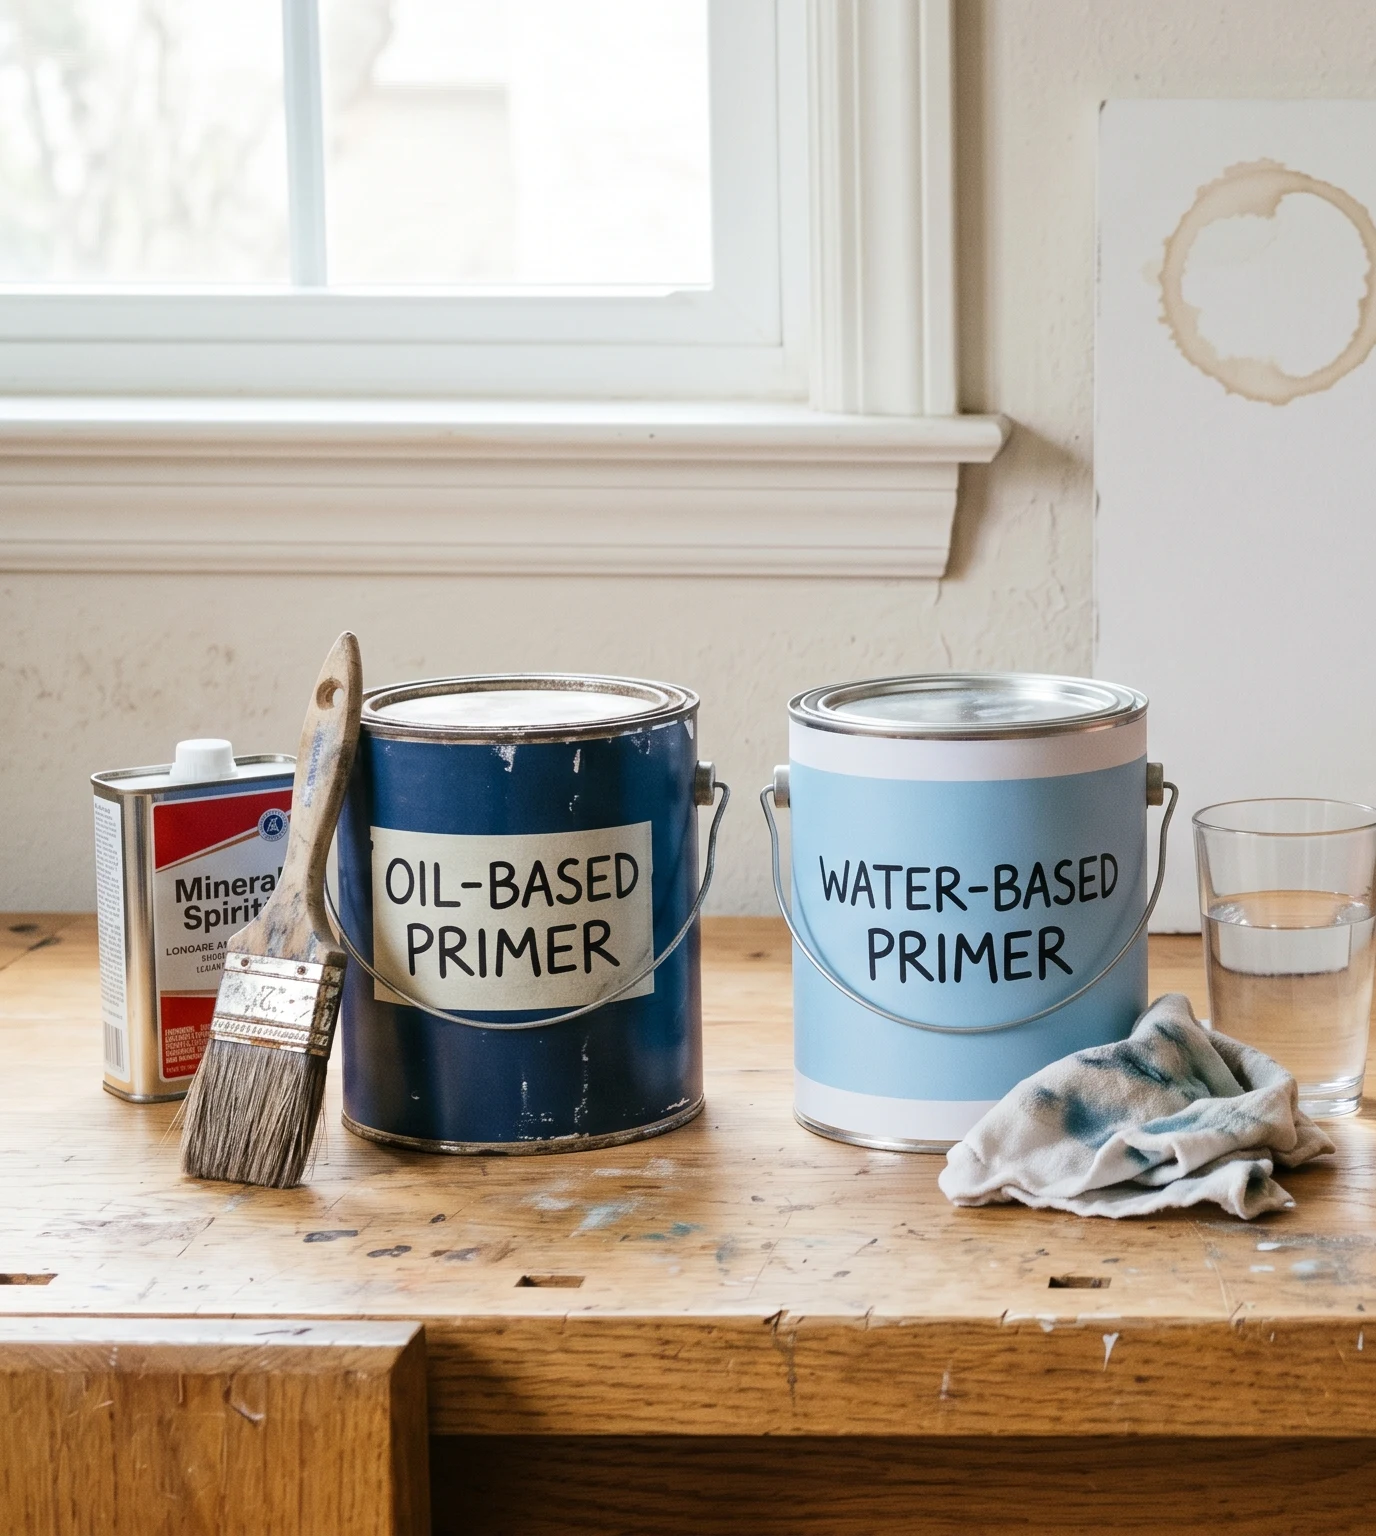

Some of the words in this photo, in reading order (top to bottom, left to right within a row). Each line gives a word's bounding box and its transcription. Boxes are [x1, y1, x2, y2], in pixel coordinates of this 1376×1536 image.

[386, 852, 639, 910] OIL-BASED
[819, 853, 1119, 913] WATER-BASED
[183, 897, 271, 934] Spirit
[407, 919, 620, 979] PRIMER
[868, 926, 1073, 983] PRIMER
